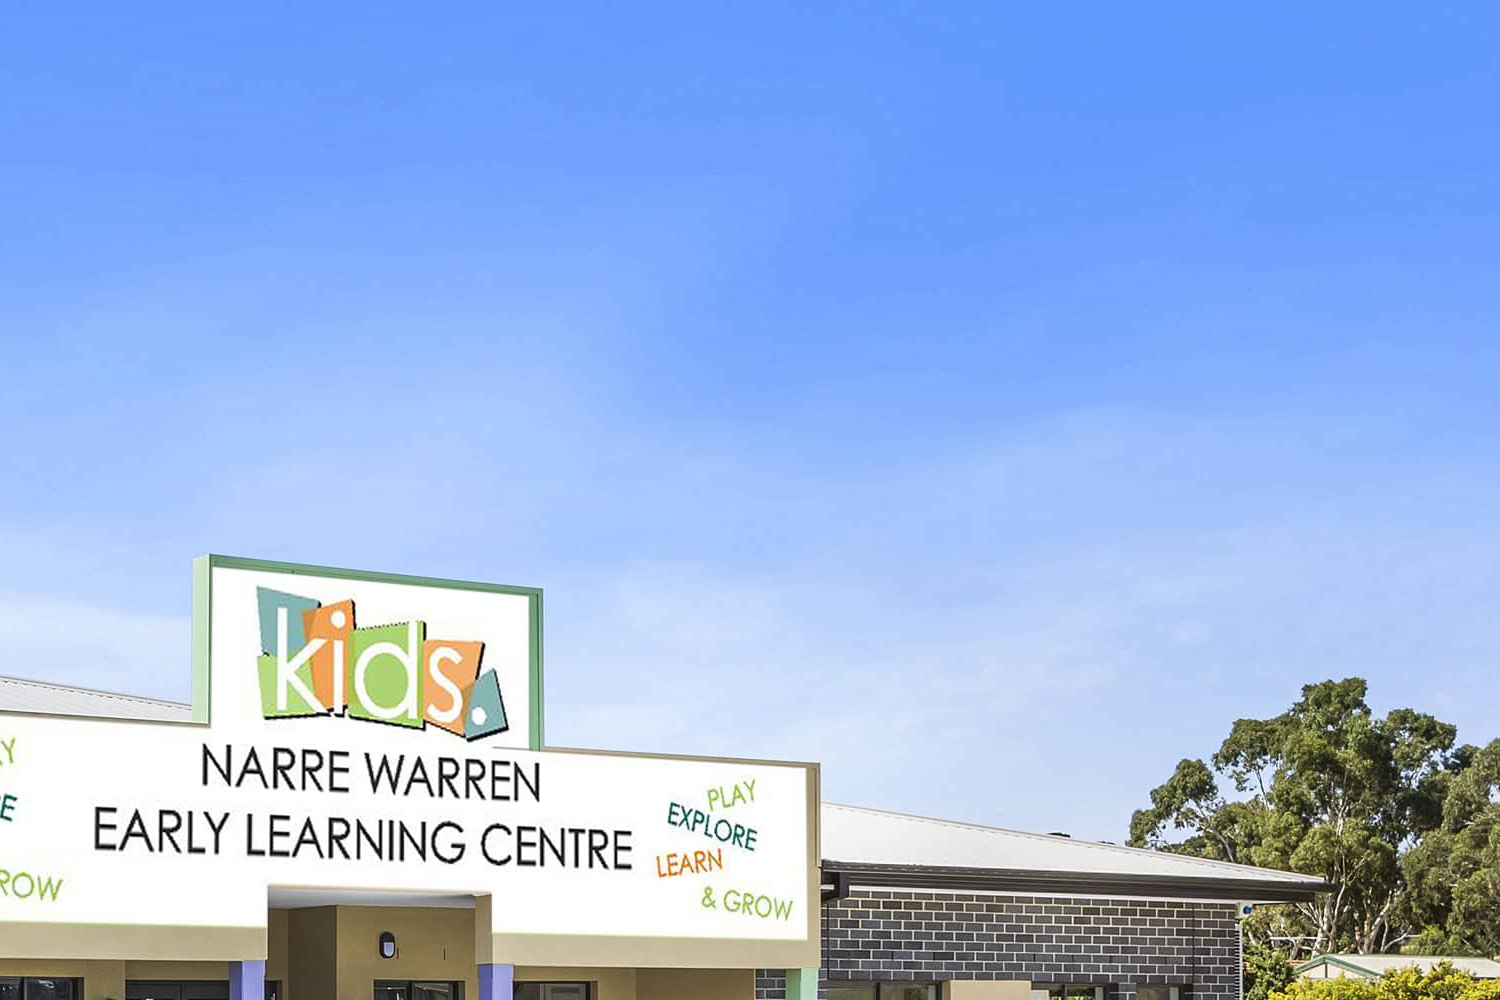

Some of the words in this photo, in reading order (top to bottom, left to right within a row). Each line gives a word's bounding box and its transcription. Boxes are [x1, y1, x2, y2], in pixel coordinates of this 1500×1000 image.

[277, 606, 488, 726] kids.
[202, 743, 349, 794] NARRE
[364, 753, 540, 802] WARREN
[708, 780, 756, 811] PLAY
[94, 806, 230, 856] EARLY
[247, 812, 466, 864] LEARNING
[480, 823, 632, 870] CENTRE
[668, 802, 757, 851] EXPLORE
[656, 848, 723, 878] LEARN
[701, 886, 717, 909] &
[724, 890, 793, 922] GROW
